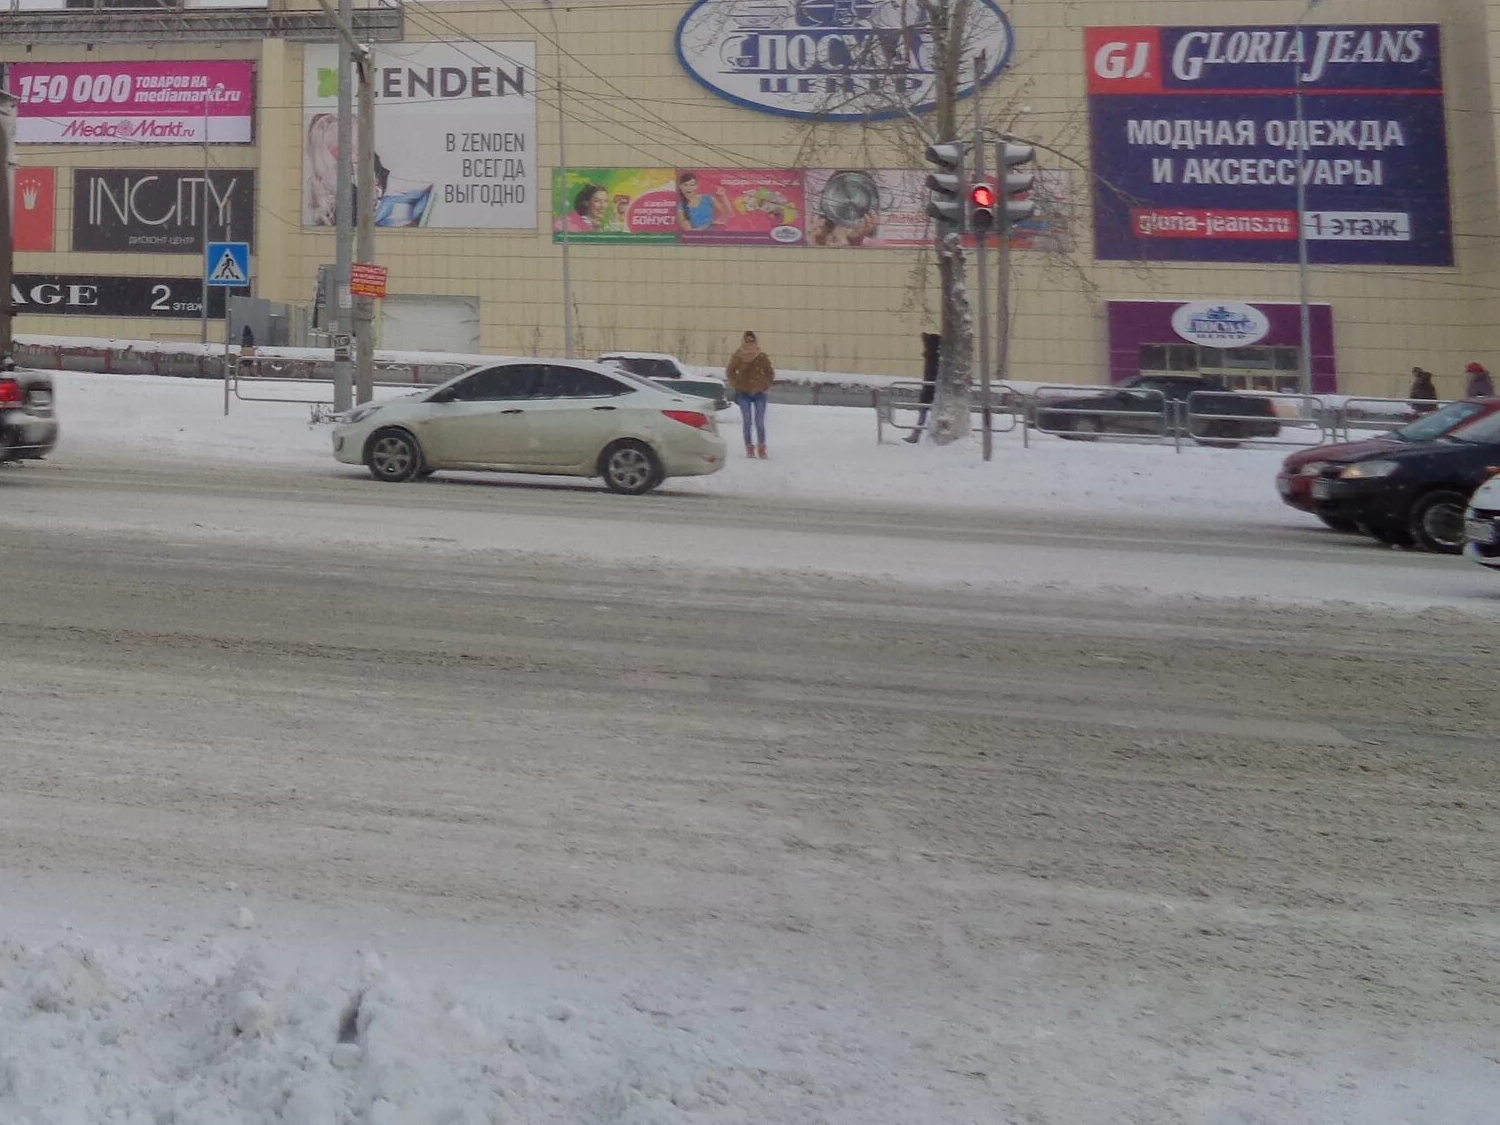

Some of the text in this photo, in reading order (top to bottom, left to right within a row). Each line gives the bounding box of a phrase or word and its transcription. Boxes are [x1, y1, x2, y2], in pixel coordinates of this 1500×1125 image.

[1094, 42, 1149, 79] GJ
[19, 74, 132, 104] 150 000
[135, 76, 208, 88] ТОВАРОВ НА
[356, 66, 525, 98] ENDEN
[135, 87, 241, 103] mediamarkt.ru
[60, 119, 118, 138] Media
[1126, 119, 1405, 151] МОДНАЯ ОДЕЖДА
[462, 133, 525, 153] ZENDEN
[462, 158, 525, 181] ВСЕГДА
[1152, 158, 1383, 186] И АКСЕССУАРЫ
[89, 176, 237, 227] INCITY
[444, 183, 525, 207] ВЫГОДНО
[1138, 211, 1290, 236] gloria-jeans.ru
[1312, 214, 1400, 237] 1 этаж
[150, 284, 171, 311] 2
